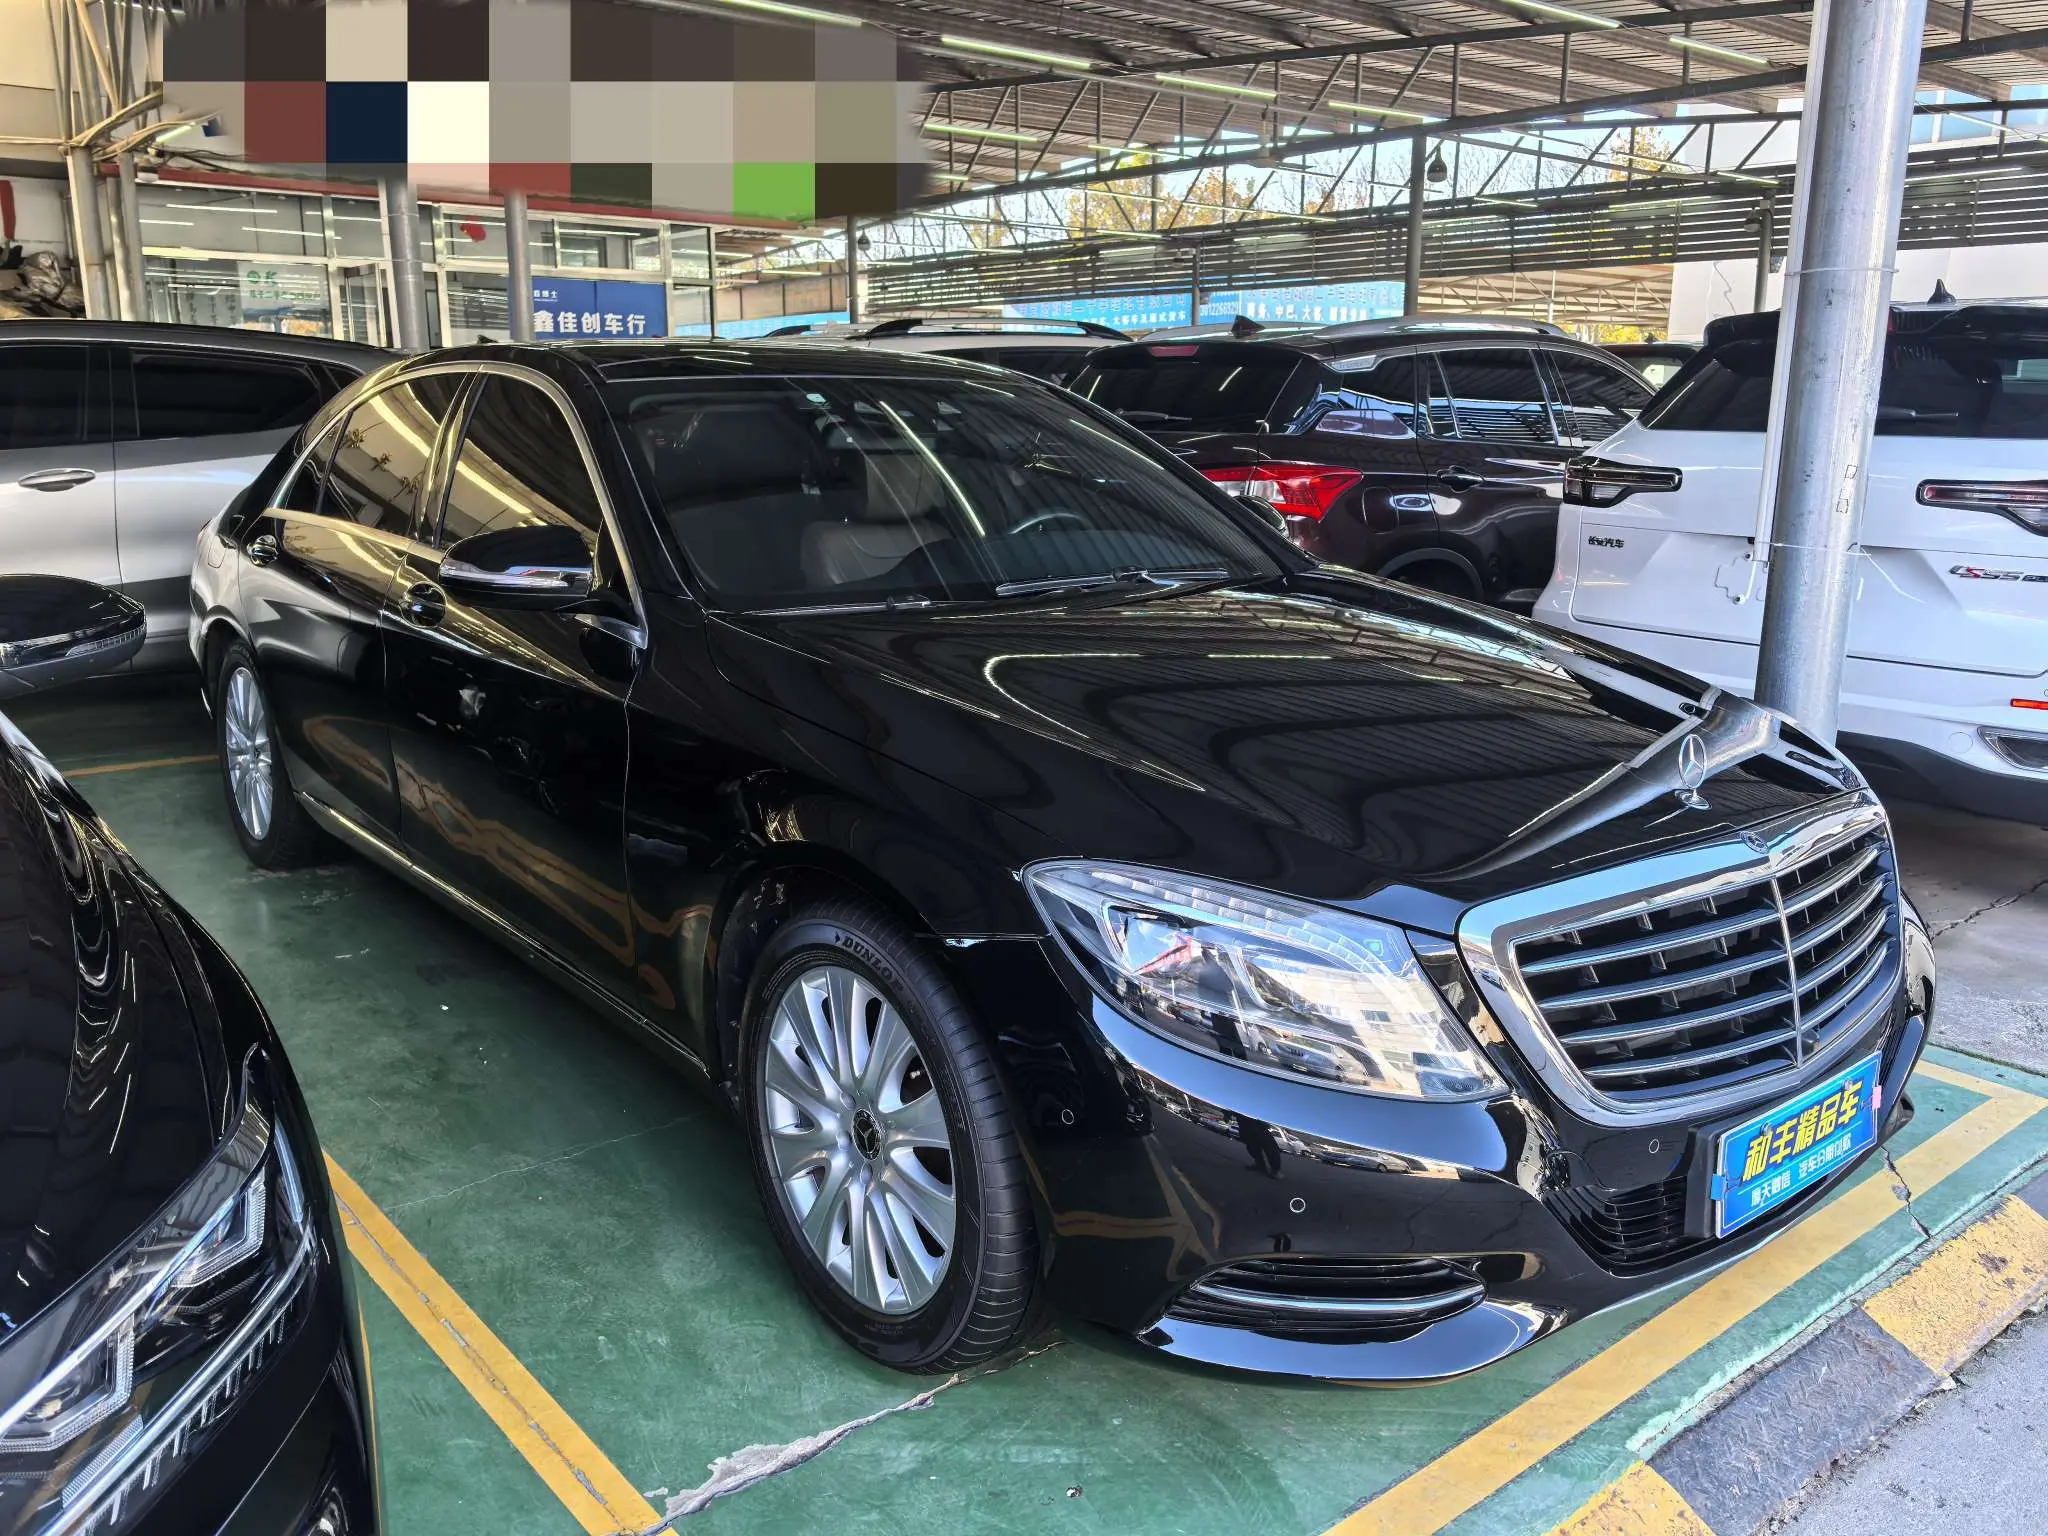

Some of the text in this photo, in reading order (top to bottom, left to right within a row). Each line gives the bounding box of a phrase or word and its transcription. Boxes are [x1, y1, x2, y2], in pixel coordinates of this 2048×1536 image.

[533, 310, 646, 336] 鑫佳创车行
